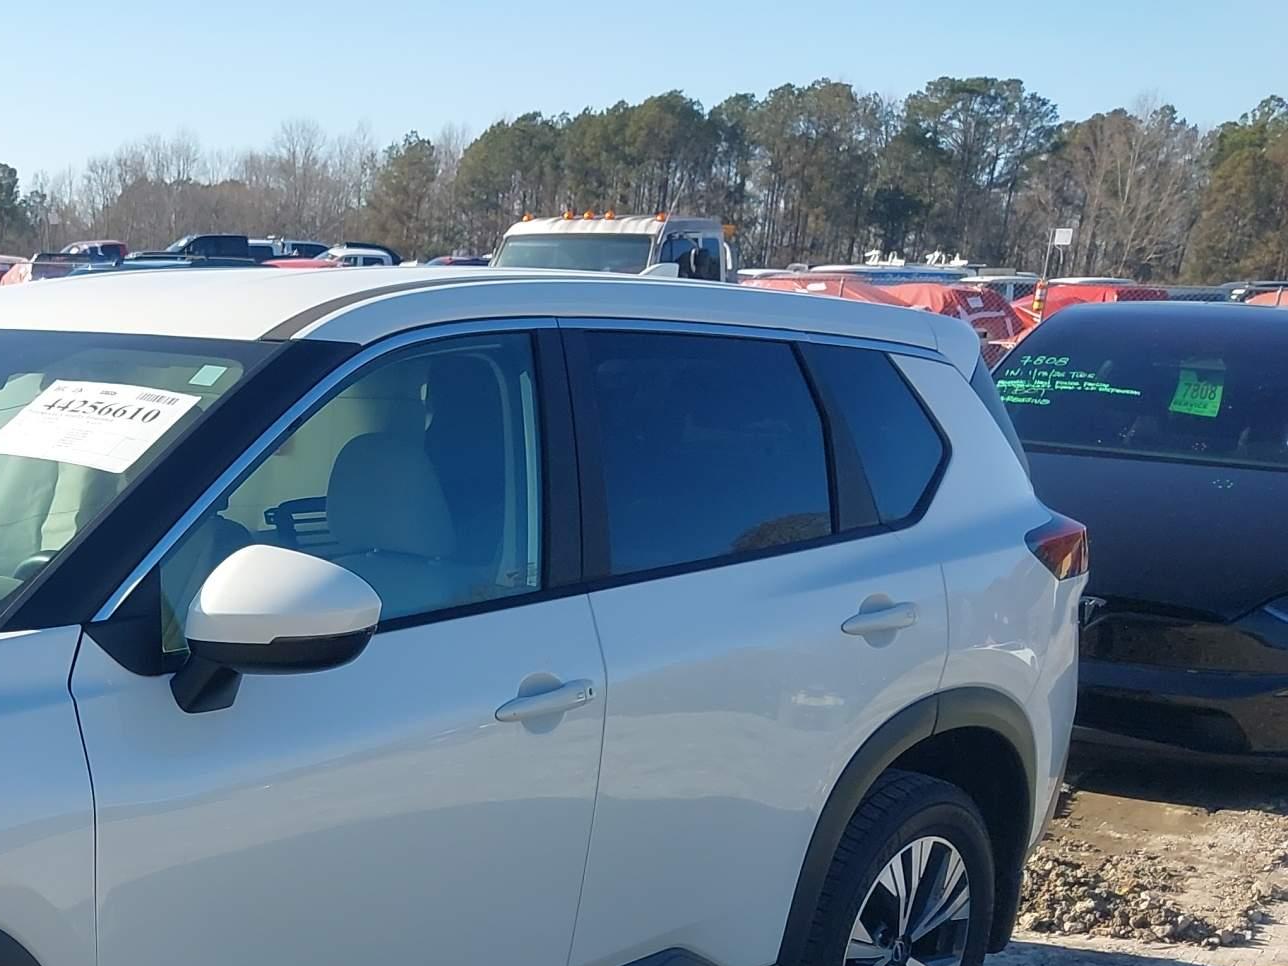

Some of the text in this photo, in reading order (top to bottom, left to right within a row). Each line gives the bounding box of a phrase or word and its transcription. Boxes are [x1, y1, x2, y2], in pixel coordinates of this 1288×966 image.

[1020, 355, 1070, 366] 7808
[1182, 382, 1218, 400] 7808
[43, 398, 161, 424] 44256610
